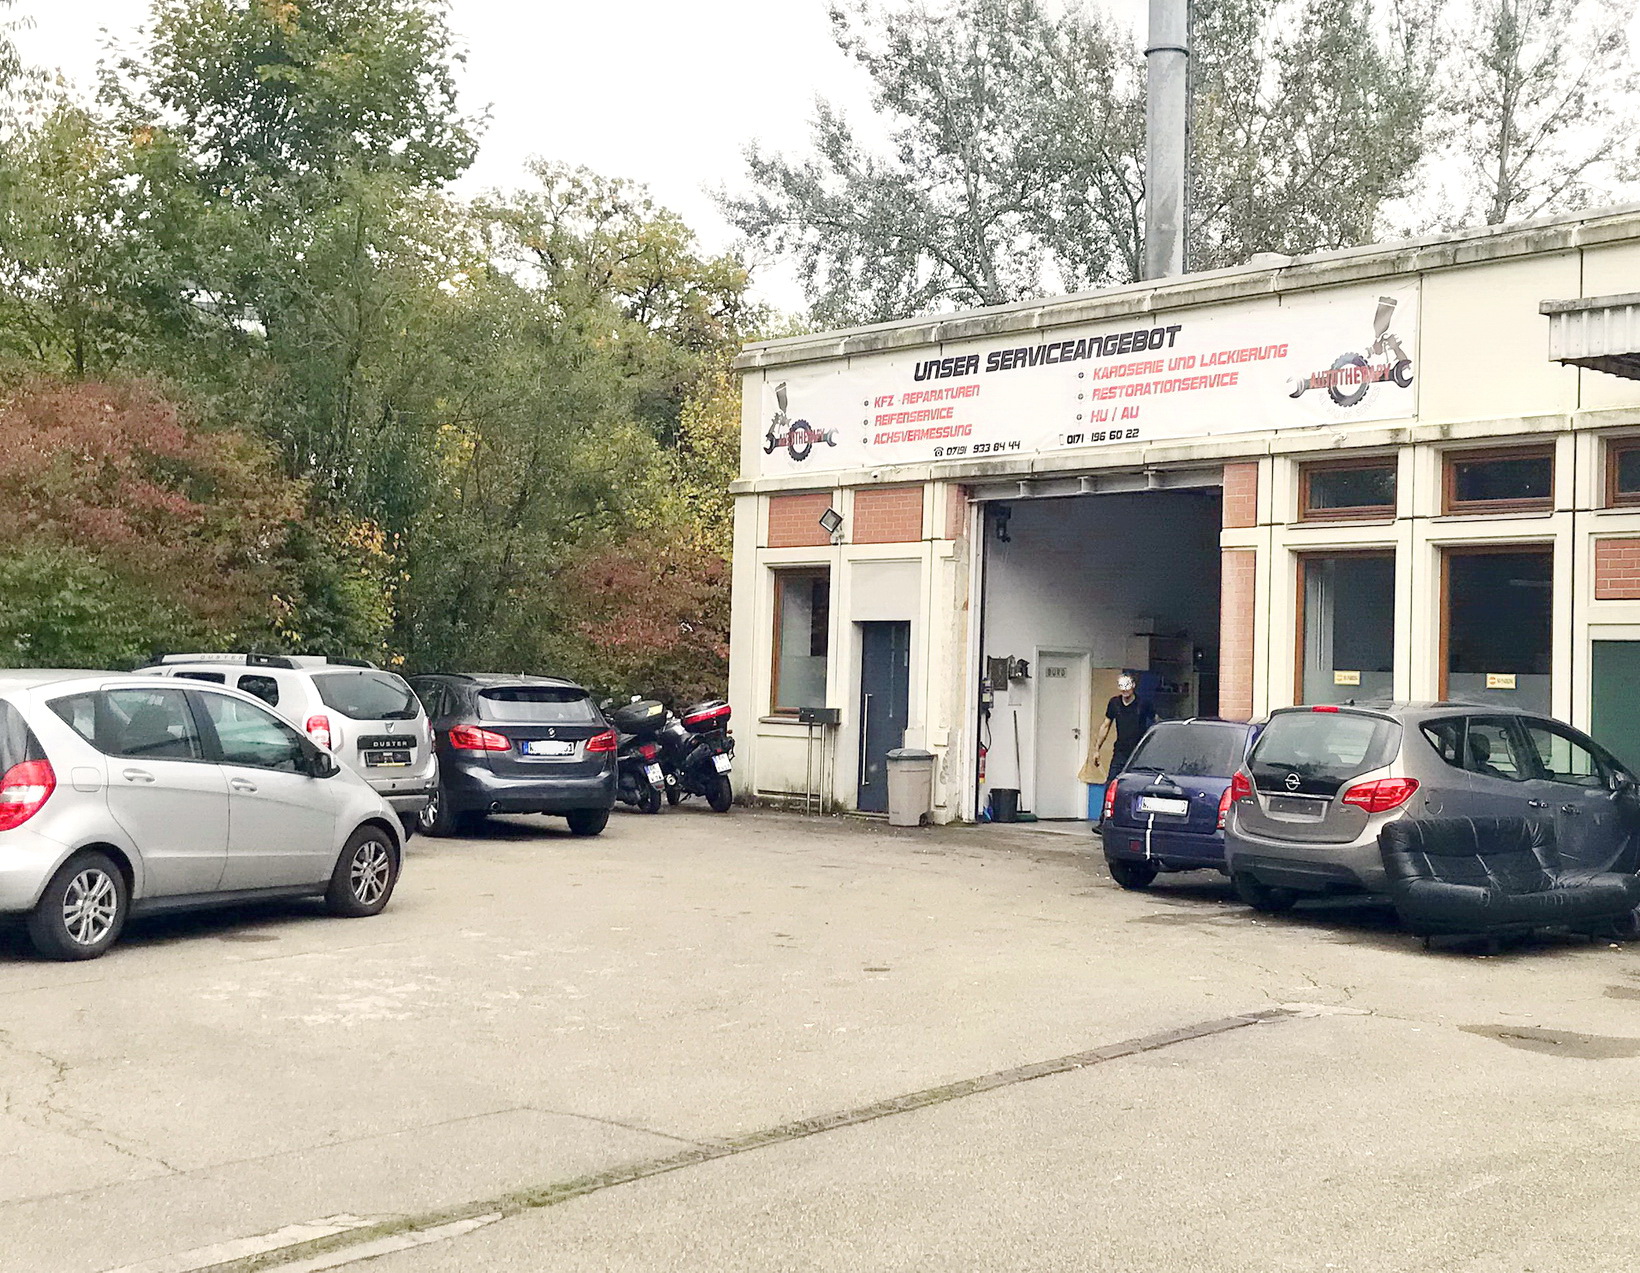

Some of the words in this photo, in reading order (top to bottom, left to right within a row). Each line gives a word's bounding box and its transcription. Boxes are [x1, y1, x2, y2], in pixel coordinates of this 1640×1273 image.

[914, 354, 980, 381] UNSER
[985, 325, 1182, 373] SERVICEANGEBOT
[1168, 355, 1196, 371] UND
[1200, 344, 1289, 367] LACKIERUNG
[1092, 372, 1239, 401] RESTORATIONSERVICE
[874, 395, 895, 409] KFZ
[874, 406, 955, 427] REIFENSERVICE
[1090, 408, 1109, 423] HU
[1121, 405, 1140, 420] AU
[873, 423, 973, 445] ACHSVERMESSUNG
[1066, 433, 1085, 445] 0171
[1091, 431, 1107, 442] 196
[1109, 429, 1123, 441] 60
[1125, 428, 1140, 439] 22
[972, 443, 991, 454] 933
[1008, 440, 1021, 450] 44
